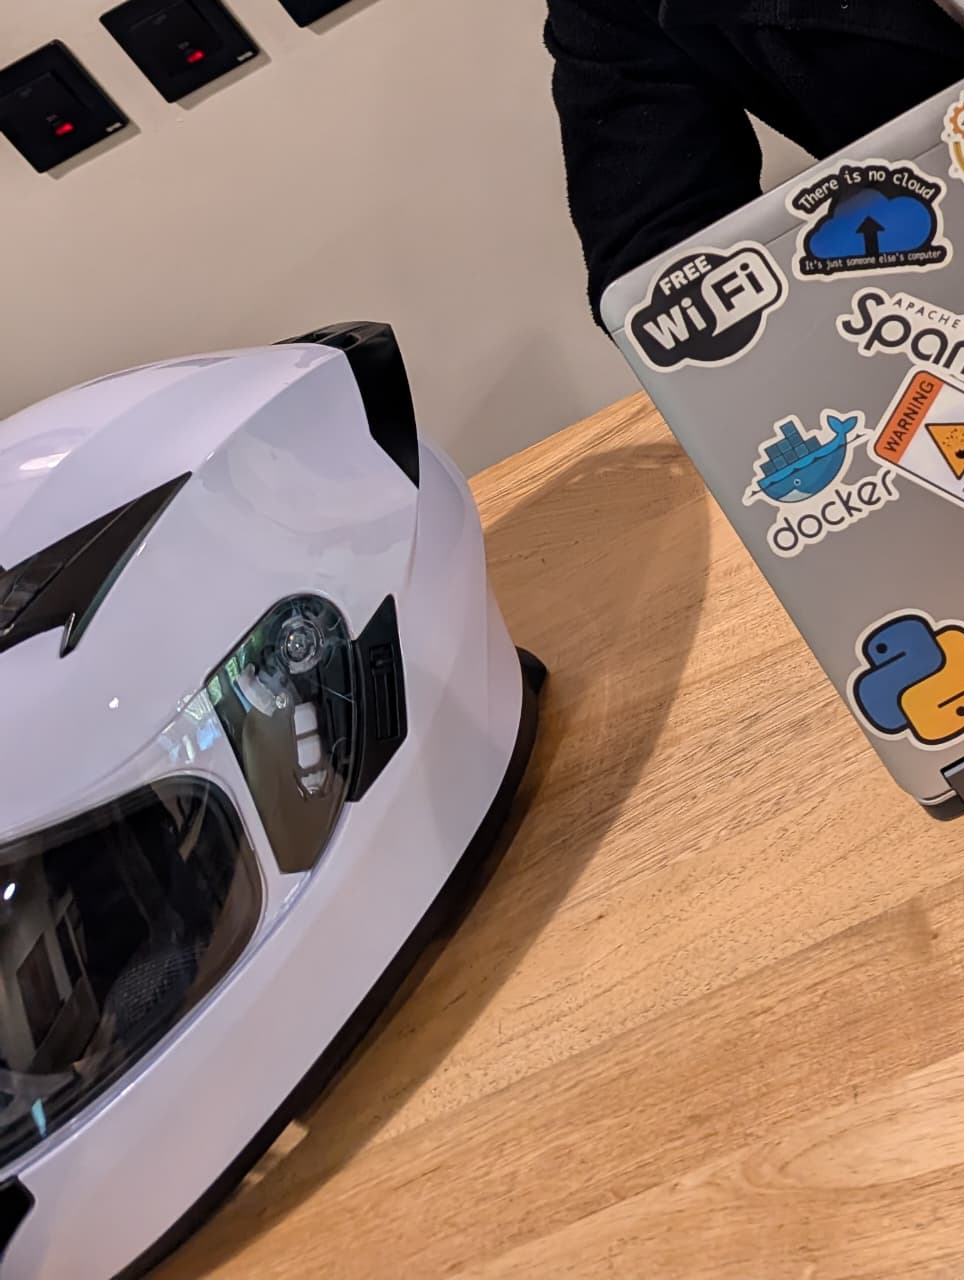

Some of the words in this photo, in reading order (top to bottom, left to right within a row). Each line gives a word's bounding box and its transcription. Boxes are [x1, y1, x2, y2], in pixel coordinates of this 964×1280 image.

[798, 180, 839, 210] There
[844, 171, 862, 185] is
[869, 171, 886, 182] no
[893, 172, 936, 200] cloud
[659, 255, 712, 296] FREE
[805, 260, 822, 270] It's
[826, 259, 843, 270] just
[846, 256, 876, 266] someone
[879, 253, 904, 264] else's
[907, 250, 942, 261] computer
[892, 298, 961, 328] APACHE
[884, 380, 934, 453] WARNING
[773, 470, 893, 551] docker
